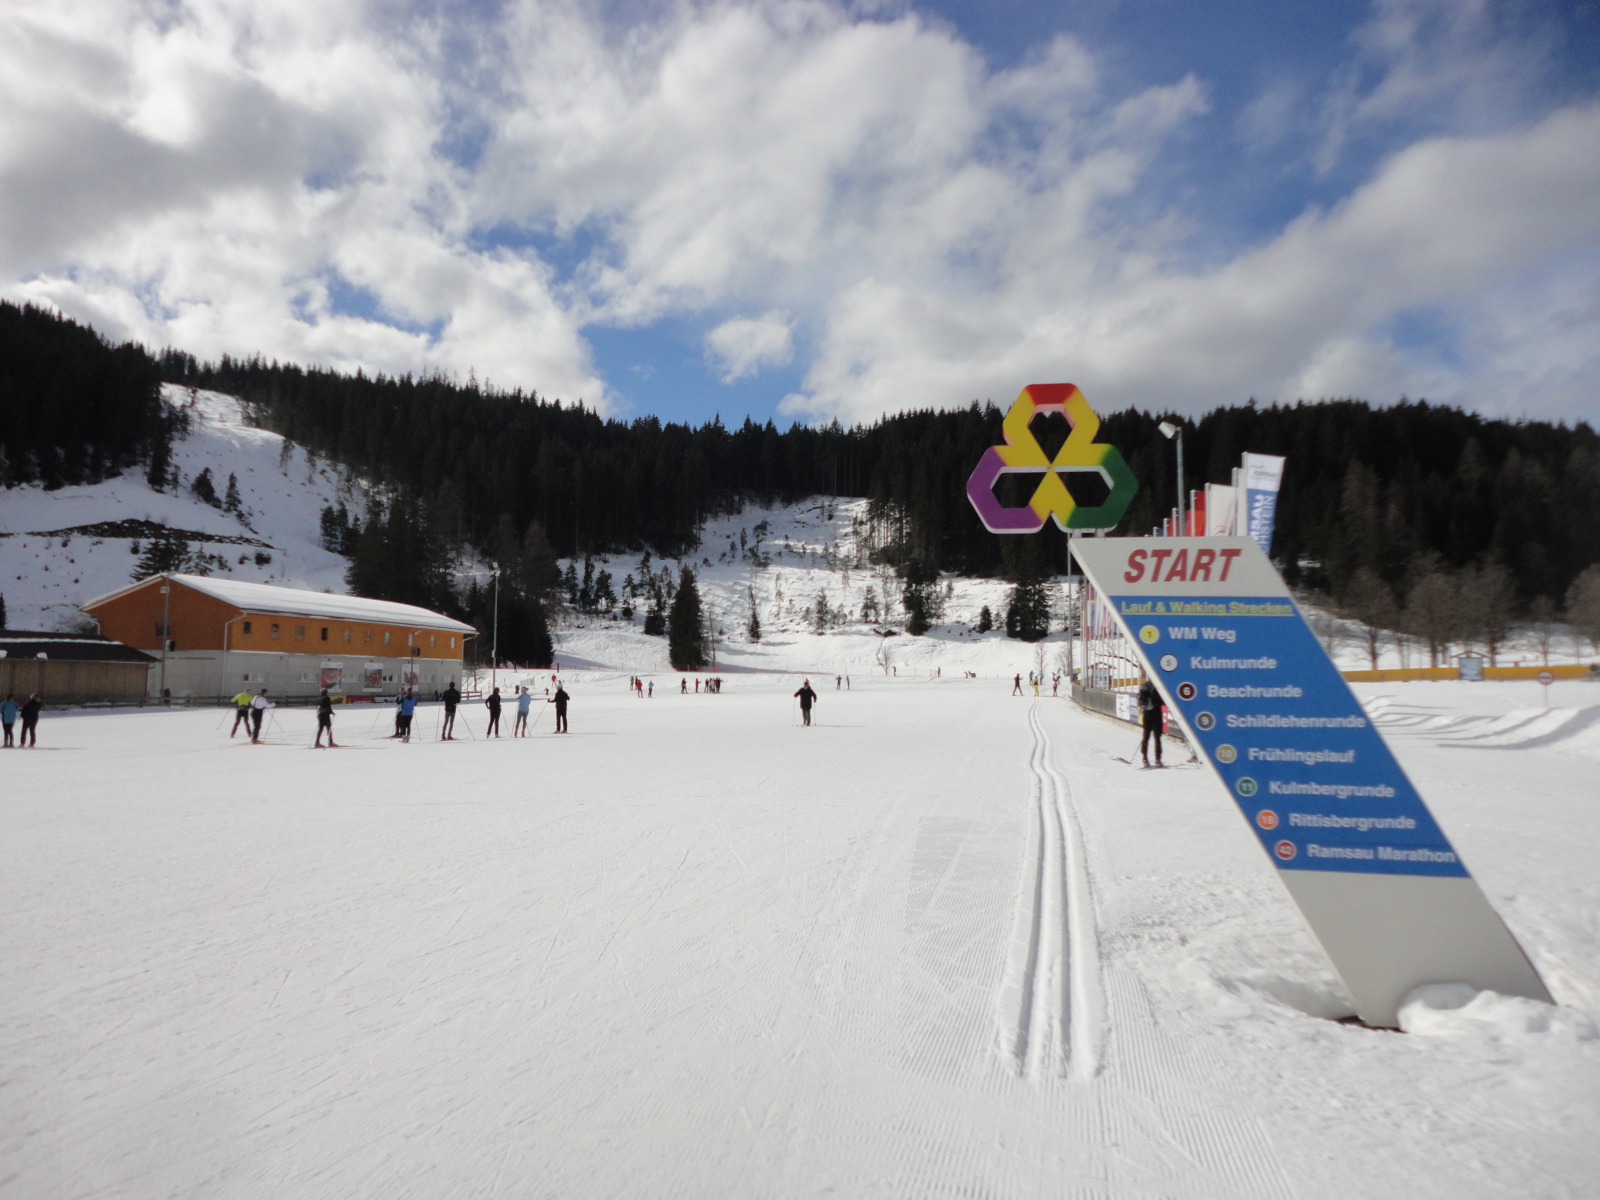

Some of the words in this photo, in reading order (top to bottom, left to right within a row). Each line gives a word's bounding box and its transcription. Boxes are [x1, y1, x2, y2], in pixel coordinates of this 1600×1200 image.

[1257, 495, 1275, 554] CHSTEIN
[1123, 548, 1243, 583] START
[1121, 601, 1153, 613] Lauf
[1156, 602, 1165, 613] &
[1170, 602, 1226, 615] Walking
[1229, 602, 1292, 613] Strecken
[1168, 627, 1197, 639] WM
[1201, 627, 1236, 643] Weg
[1190, 657, 1277, 669] Kulmrunde
[1183, 687, 1190, 696] 6
[1207, 685, 1303, 698] Beachrunde
[1202, 717, 1208, 725] 9
[1226, 715, 1366, 728] Schildlehenrunde
[1220, 750, 1232, 758] 10
[1247, 747, 1355, 765] Frühlingslauf
[1241, 783, 1252, 791] 11
[1269, 781, 1395, 799] Kulmbergrunde
[1289, 813, 1416, 831] Rittisbergrunde
[1278, 845, 1292, 855] 42
[1307, 844, 1374, 859] Ramsau
[1377, 847, 1456, 863] Marathon
